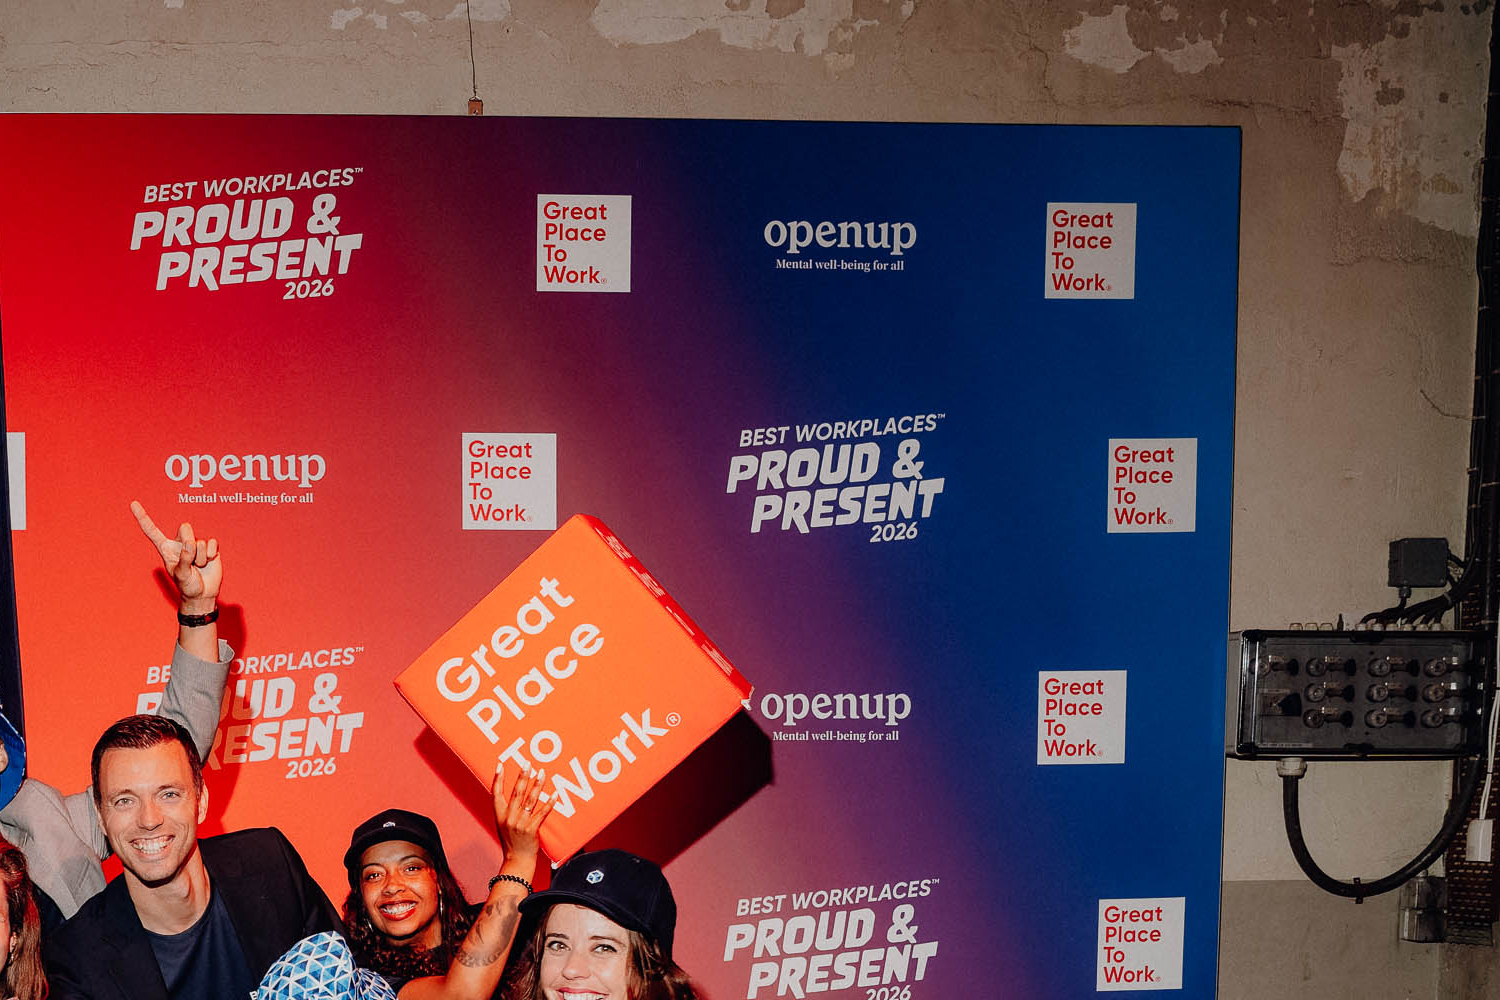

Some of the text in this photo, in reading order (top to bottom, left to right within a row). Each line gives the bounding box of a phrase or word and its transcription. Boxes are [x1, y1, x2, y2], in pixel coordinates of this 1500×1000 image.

[144, 182, 197, 203] BEST
[544, 202, 607, 220] Great
[1052, 210, 1113, 228] Great
[130, 194, 340, 250] PROUD &
[546, 223, 606, 241] Place
[764, 221, 916, 255] openup
[1054, 231, 1112, 249] Place
[156, 233, 363, 291] PRESENT
[543, 244, 567, 262] To
[1052, 252, 1074, 270] To
[776, 259, 903, 273] Mental well-being for all
[283, 278, 334, 299] 2026
[740, 426, 790, 447] BEST
[469, 440, 532, 458] Great
[1114, 445, 1172, 463] Great
[165, 455, 325, 487] openup
[471, 462, 531, 479] Place
[727, 439, 924, 493] PROUD &
[1116, 466, 1172, 483] Place
[178, 493, 313, 506] Mental well-being for all
[469, 483, 492, 500] To
[1114, 487, 1136, 504] To
[751, 478, 944, 533] PRESENT
[870, 522, 917, 542] 2026
[436, 577, 574, 702] Great
[467, 623, 604, 744] Place
[1045, 678, 1103, 695] Great
[309, 673, 341, 714] &
[761, 694, 911, 726] openup
[1046, 699, 1102, 715] Place
[1044, 719, 1066, 736] To
[773, 731, 898, 743] Mental well-being for all
[498, 730, 562, 779] To
[285, 757, 336, 779] 2026
[737, 895, 787, 916] BEST
[1105, 906, 1162, 923] Great
[724, 904, 918, 961] PROUD &
[1106, 927, 1161, 943] Place
[1104, 947, 1124, 963] To
[747, 942, 938, 999] PRESENT
